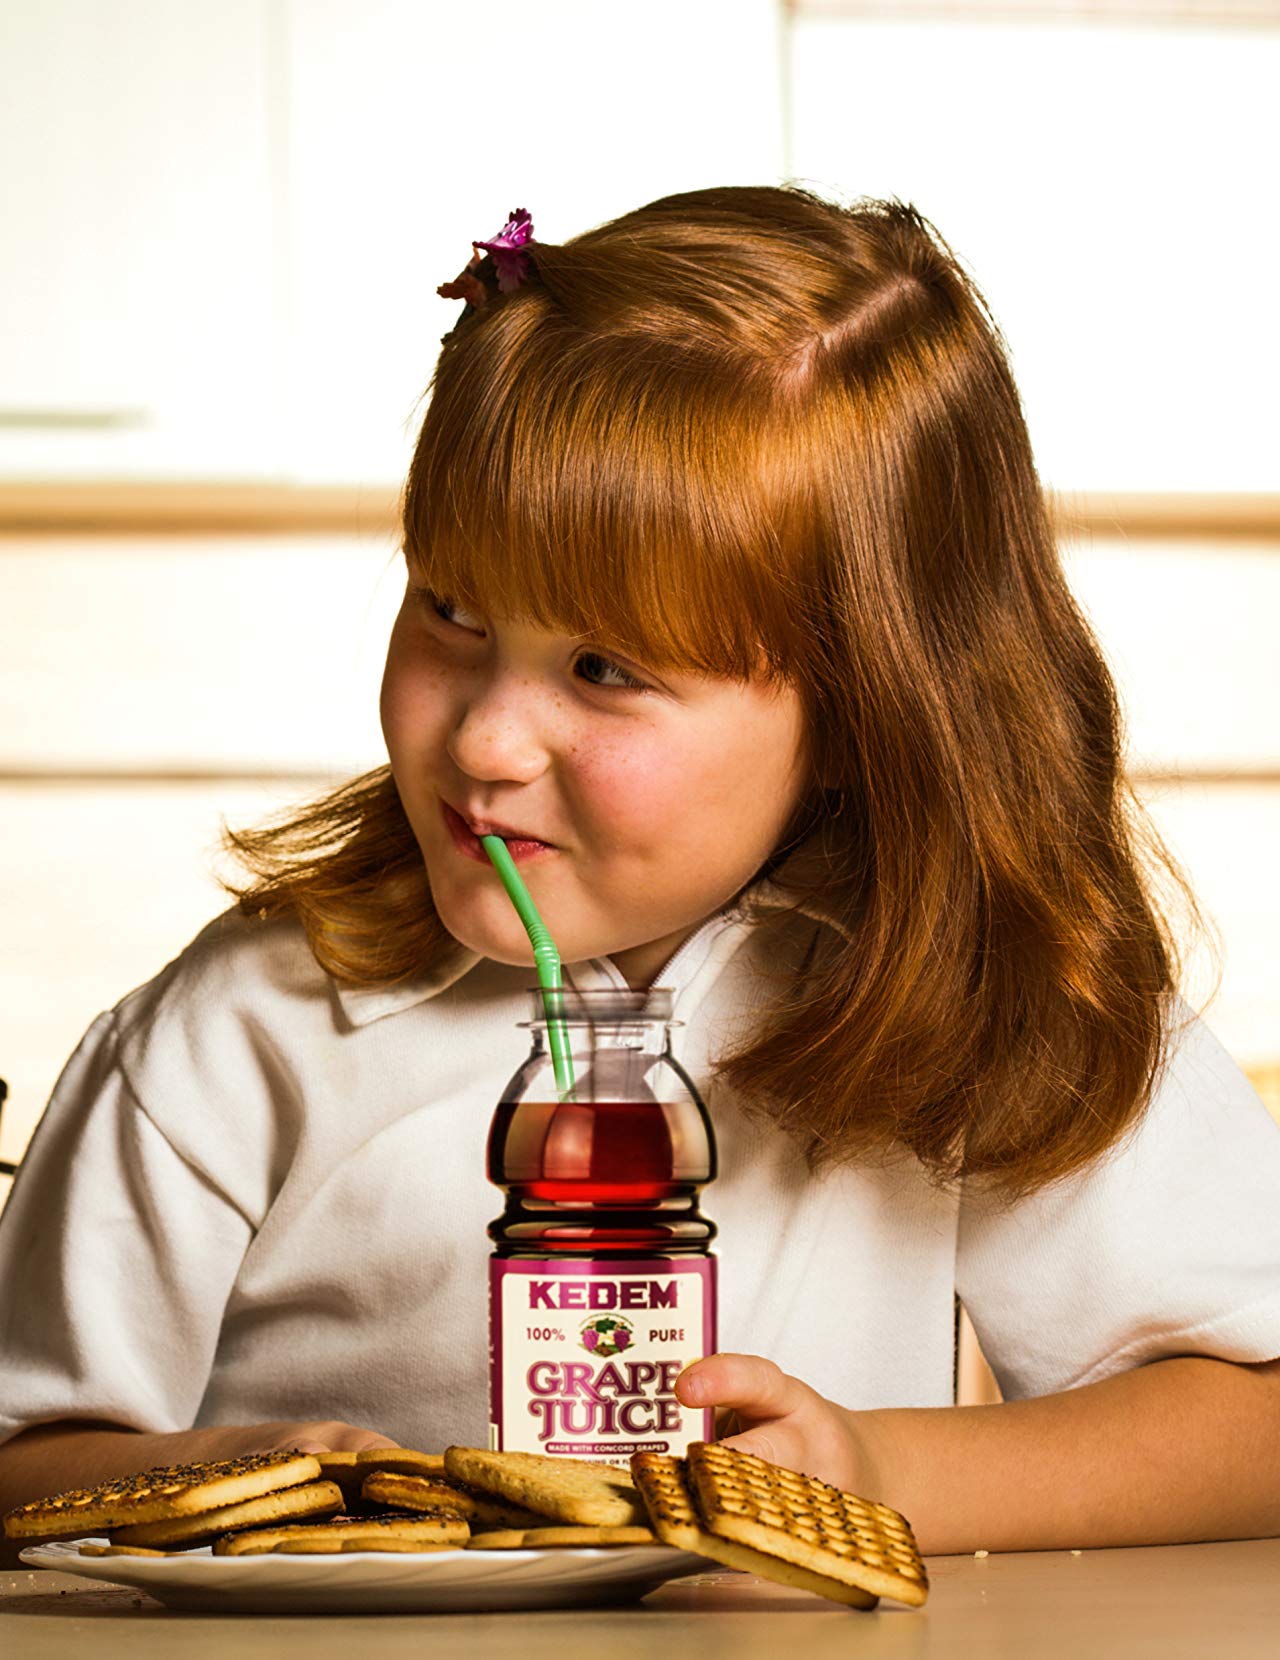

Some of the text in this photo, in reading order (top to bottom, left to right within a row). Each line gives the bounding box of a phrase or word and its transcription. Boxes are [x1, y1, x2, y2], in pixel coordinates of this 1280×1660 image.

[528, 1281, 678, 1310] KEDEM
[526, 1327, 685, 1342] 100% PURE
[526, 1360, 683, 1404] GRAPE
[527, 1398, 683, 1442] JUICE
[548, 1443, 666, 1453] MADE WITH CONCORD GRAPES
